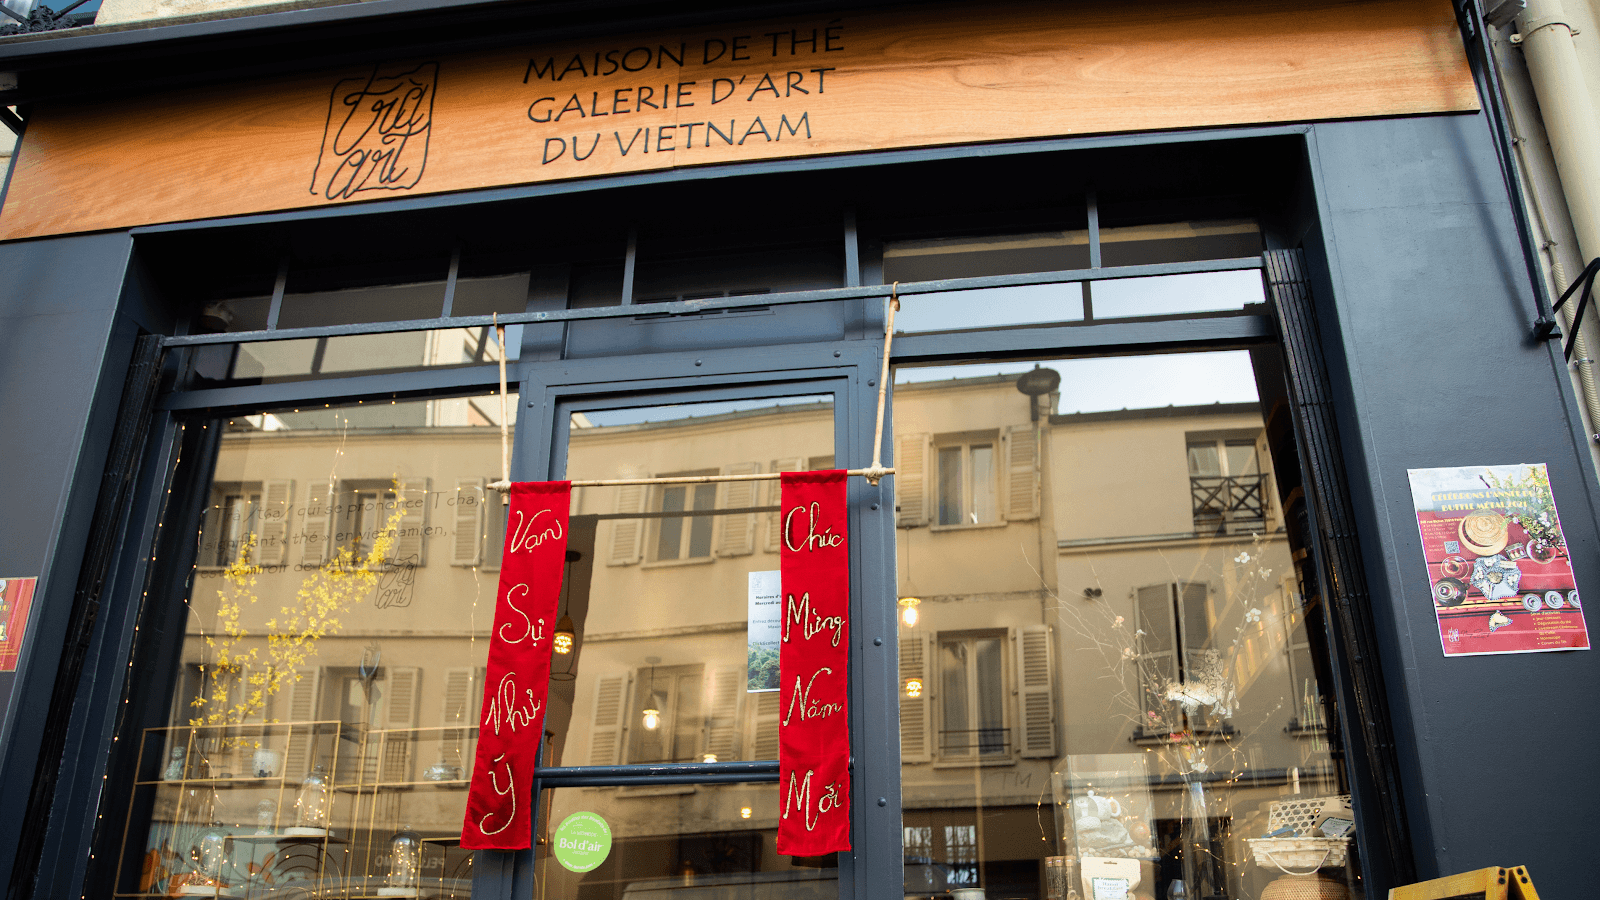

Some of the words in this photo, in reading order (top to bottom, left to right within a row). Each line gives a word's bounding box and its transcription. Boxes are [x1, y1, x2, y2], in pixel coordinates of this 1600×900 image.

[523, 42, 686, 84] MAISON
[702, 36, 751, 65] DE
[764, 19, 844, 57] THÉ
[527, 81, 696, 123] GALERIE
[711, 67, 836, 105] D'ART
[542, 133, 601, 165] DU
[614, 112, 812, 156] VIETNAM
[293, 528, 318, 545] thé
[297, 502, 323, 523] qui
[324, 503, 342, 516] se
[346, 498, 423, 520] prononce
[785, 501, 845, 552] Chúc
[783, 667, 843, 726] Năm
[559, 837, 577, 850] Bol
[578, 839, 604, 852] d'air
